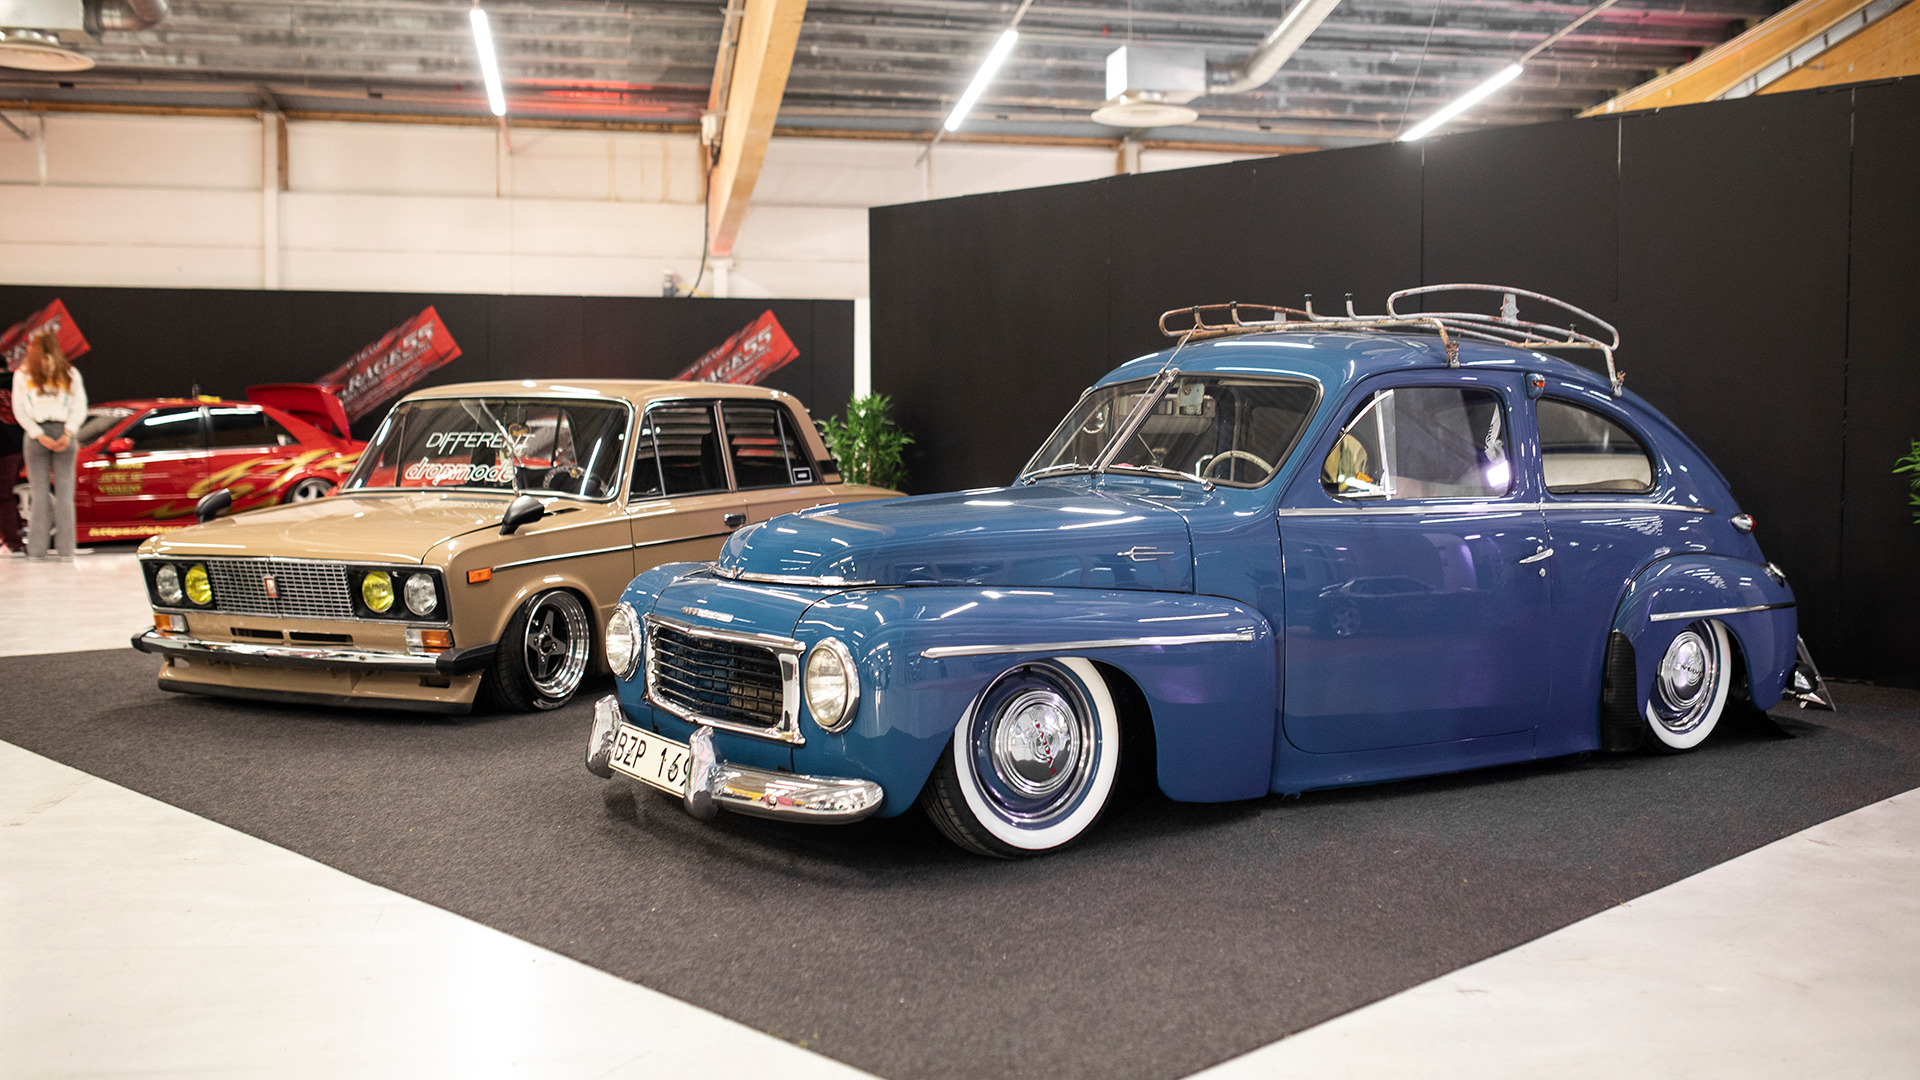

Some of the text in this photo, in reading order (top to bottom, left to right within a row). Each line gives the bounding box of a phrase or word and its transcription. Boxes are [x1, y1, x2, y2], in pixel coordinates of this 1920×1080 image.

[425, 431, 536, 456] DIFFERENT
[404, 456, 518, 486] dropmode
[613, 731, 648, 769] BZP
